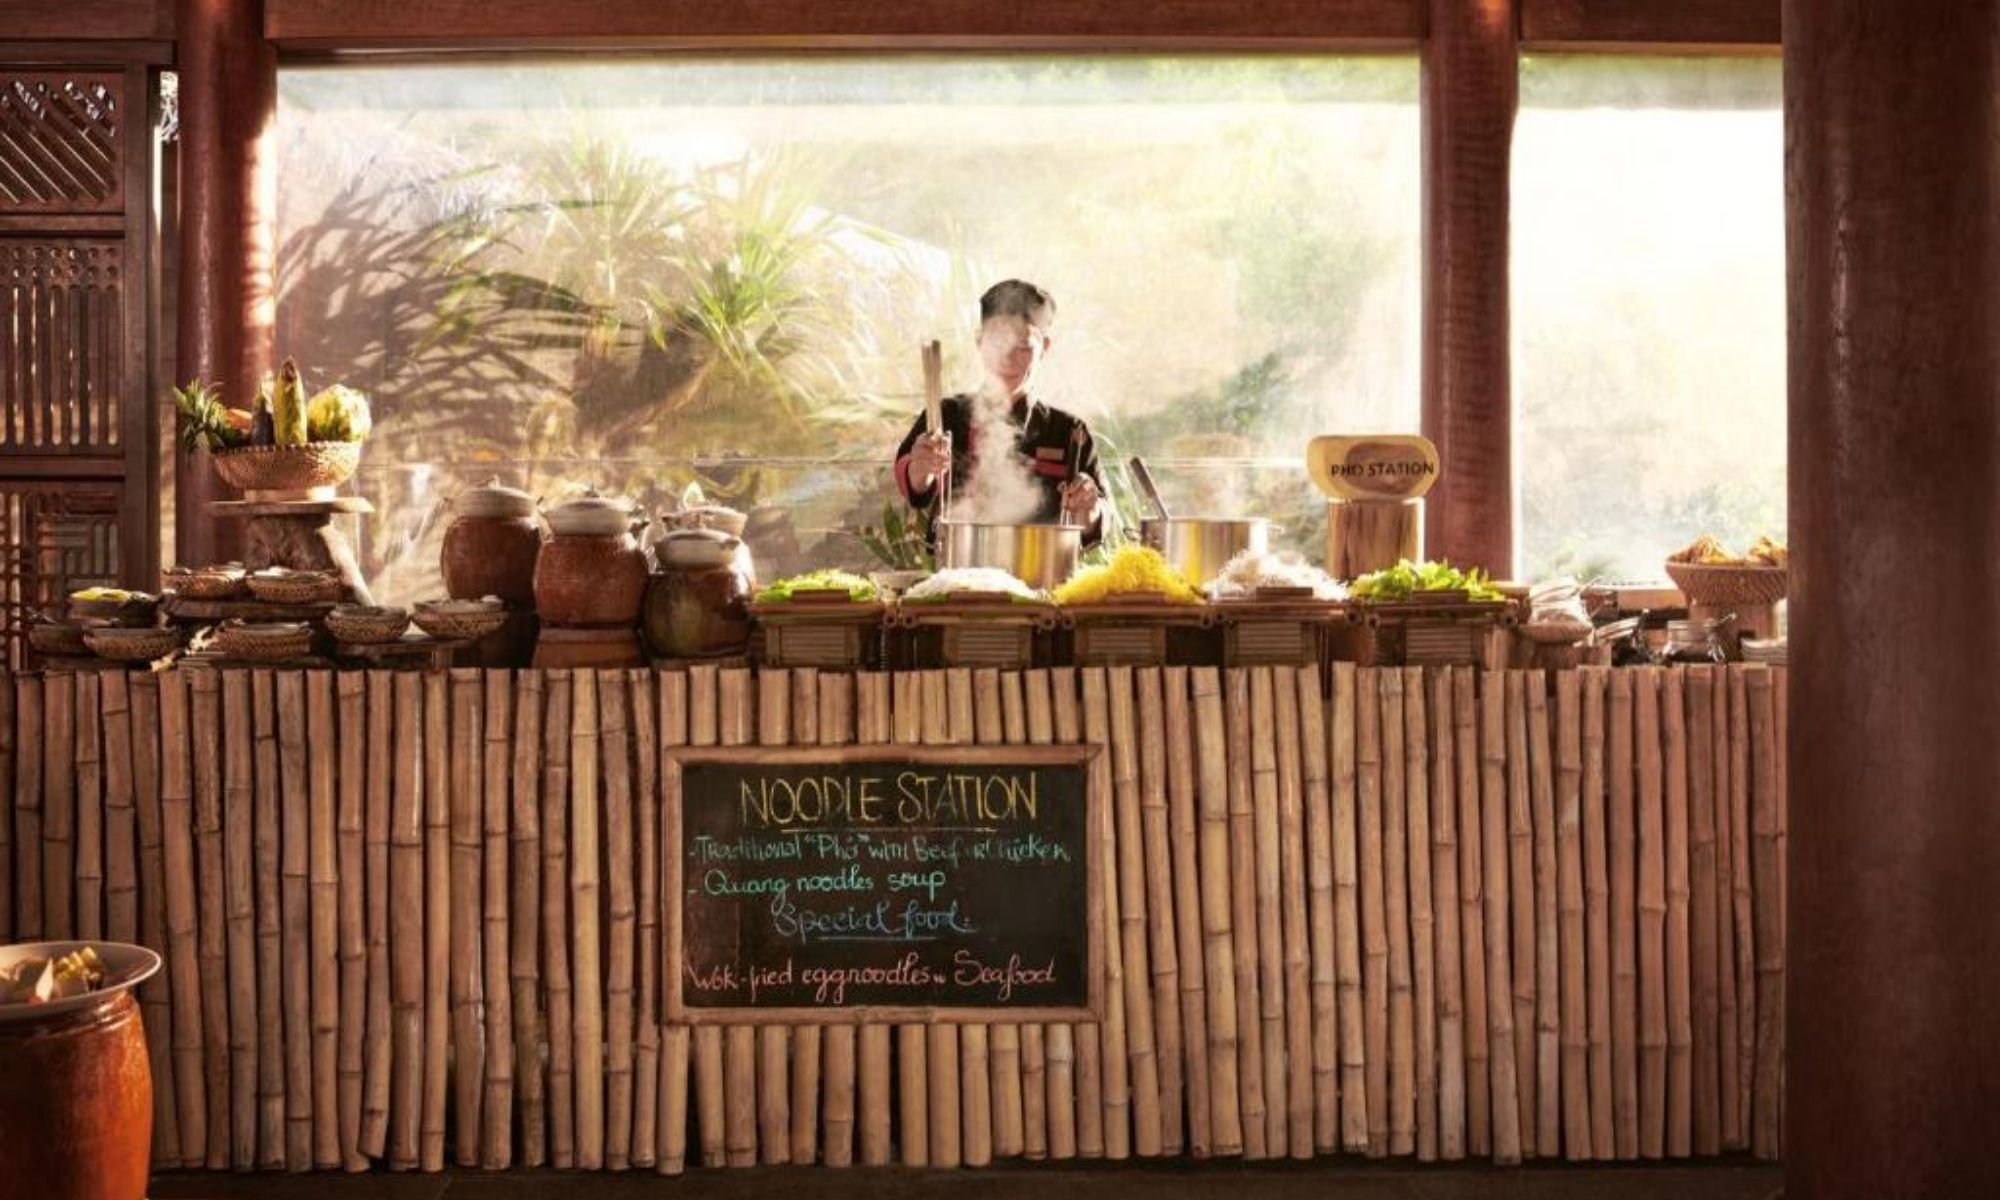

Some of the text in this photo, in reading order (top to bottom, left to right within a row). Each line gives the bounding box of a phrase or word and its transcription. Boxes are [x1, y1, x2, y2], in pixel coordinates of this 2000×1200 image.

[1330, 461, 1434, 478] PHO STATION
[740, 771, 1037, 825] NOODLE STATION
[704, 868, 789, 916] Quang
[797, 864, 874, 892] noodles
[887, 871, 946, 902] soup
[774, 900, 899, 945] Special
[954, 950, 1057, 1001] Seafood
